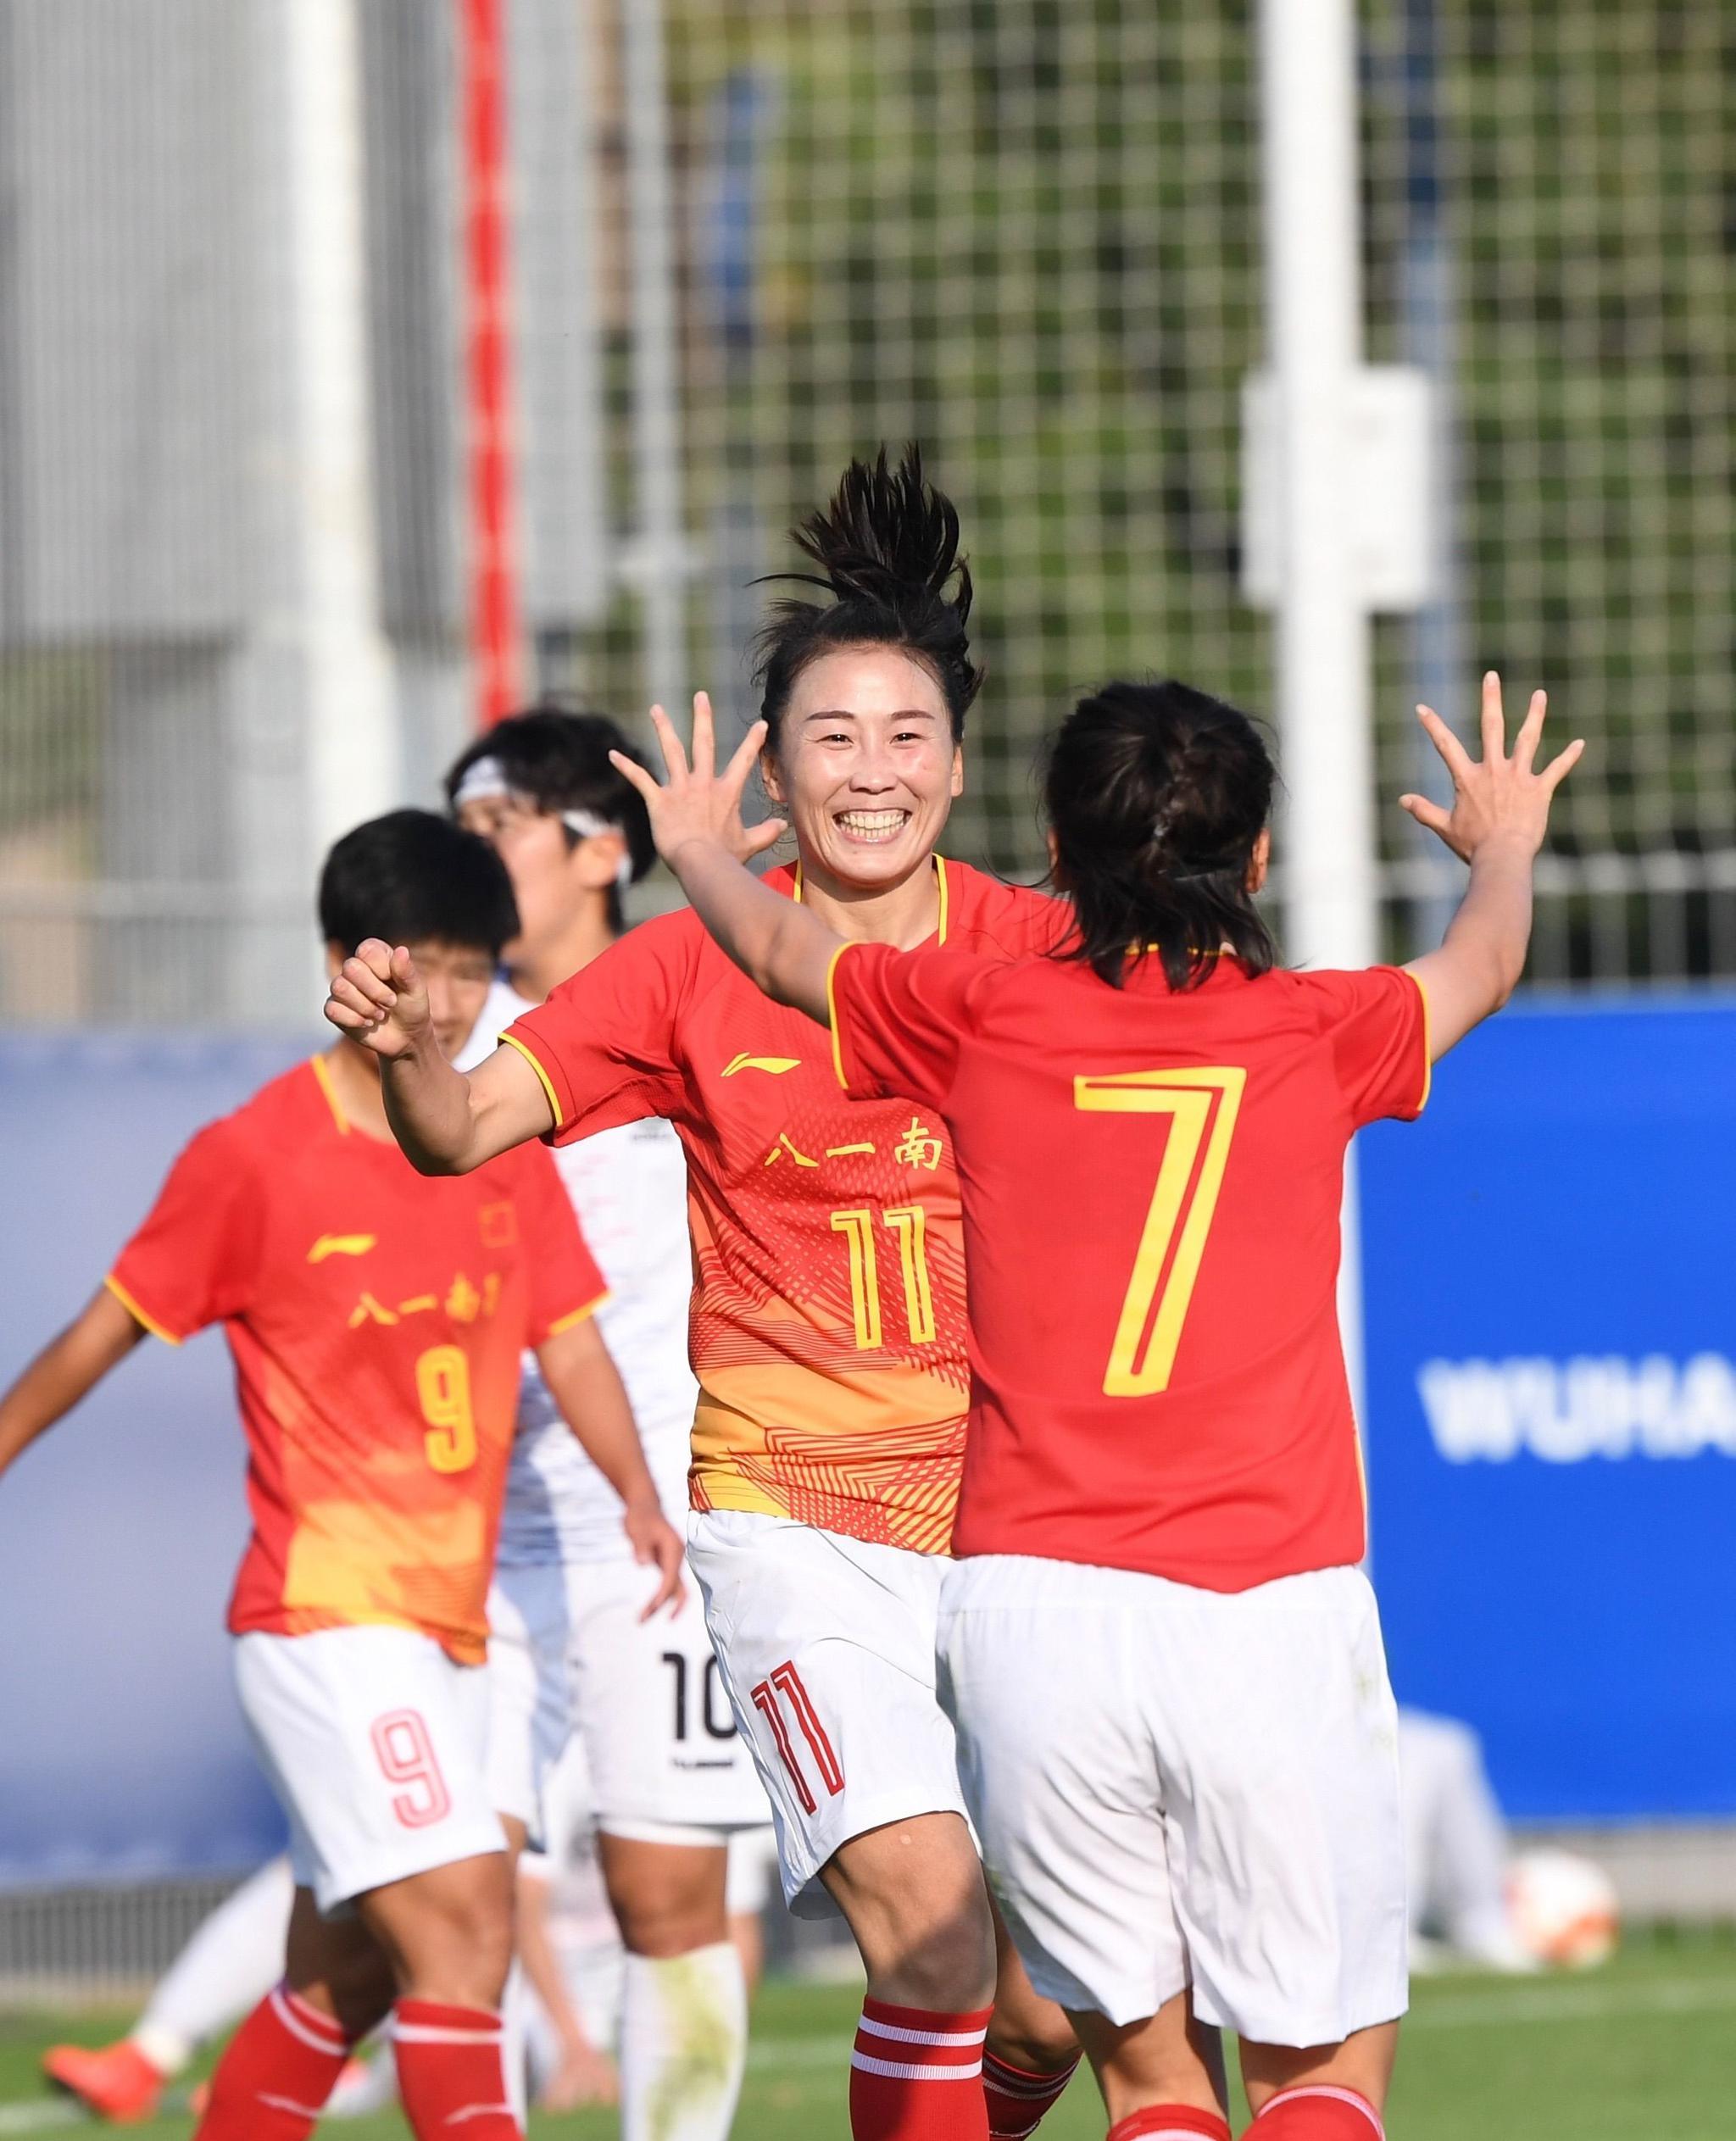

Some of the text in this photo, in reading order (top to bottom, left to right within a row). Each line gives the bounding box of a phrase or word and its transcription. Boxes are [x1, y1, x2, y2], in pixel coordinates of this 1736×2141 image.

[764, 1116, 943, 1171] 八一南
[830, 1204, 936, 1350] 11
[1073, 1065, 1248, 1398] 7
[415, 1344, 477, 1475] 9
[1416, 1353, 1736, 1464] WUHA
[662, 1652, 738, 1740] 10
[750, 1660, 845, 1815] 11
[370, 1708, 453, 1829] 9
